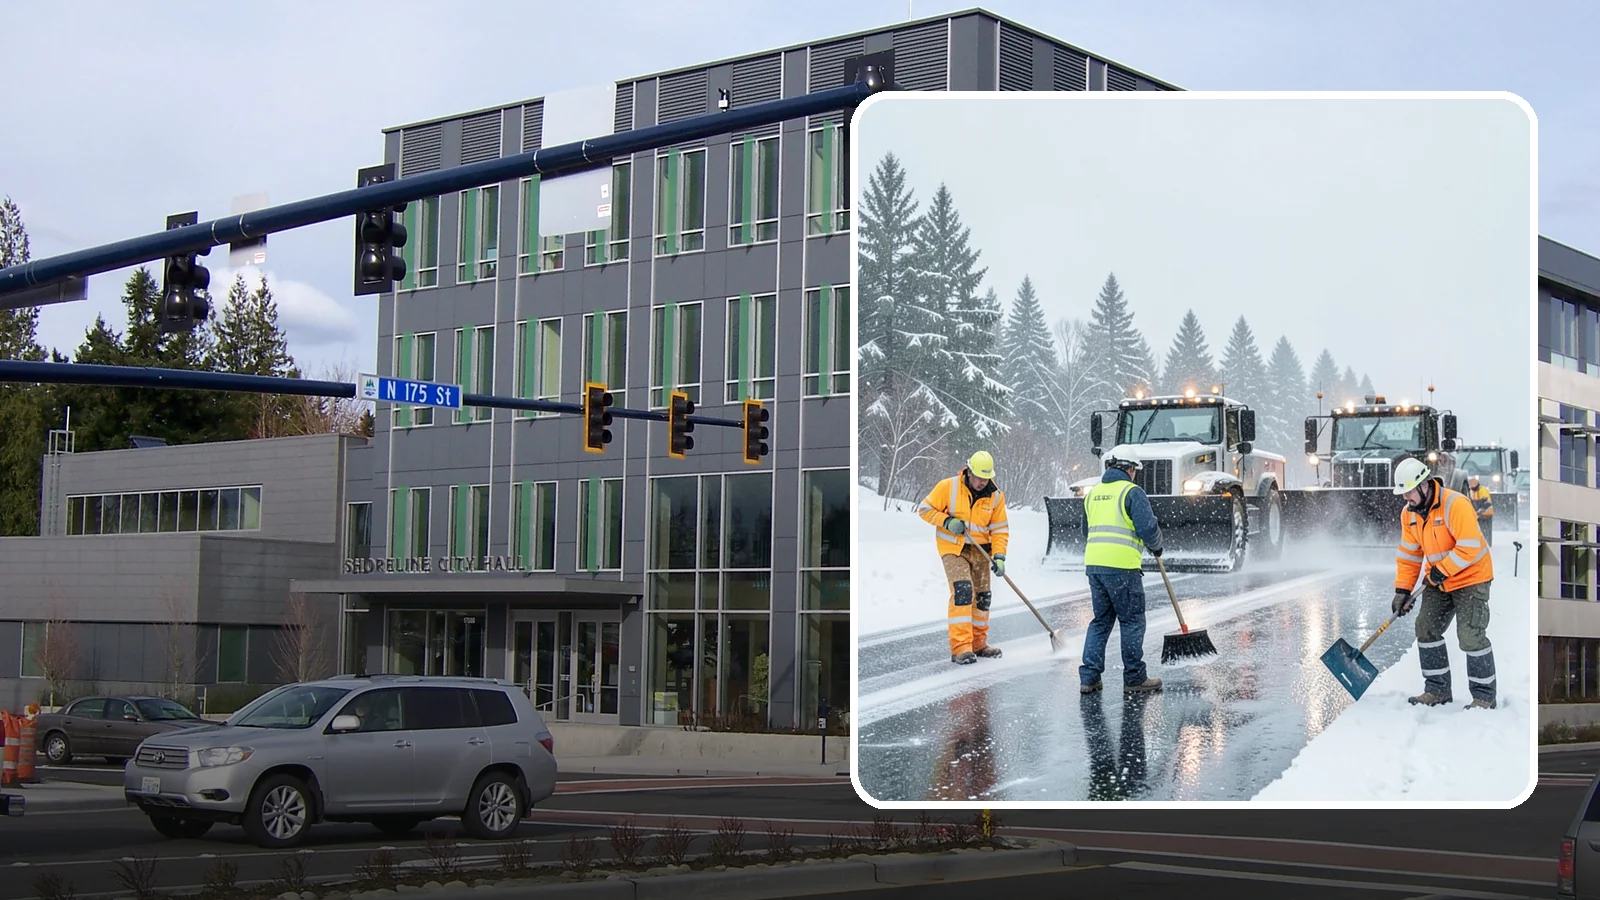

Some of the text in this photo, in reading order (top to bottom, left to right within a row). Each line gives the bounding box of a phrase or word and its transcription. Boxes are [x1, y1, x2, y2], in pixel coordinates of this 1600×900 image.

[387, 380, 452, 406] N 175 St
[344, 556, 526, 574] SHORELINE CITY HALL
